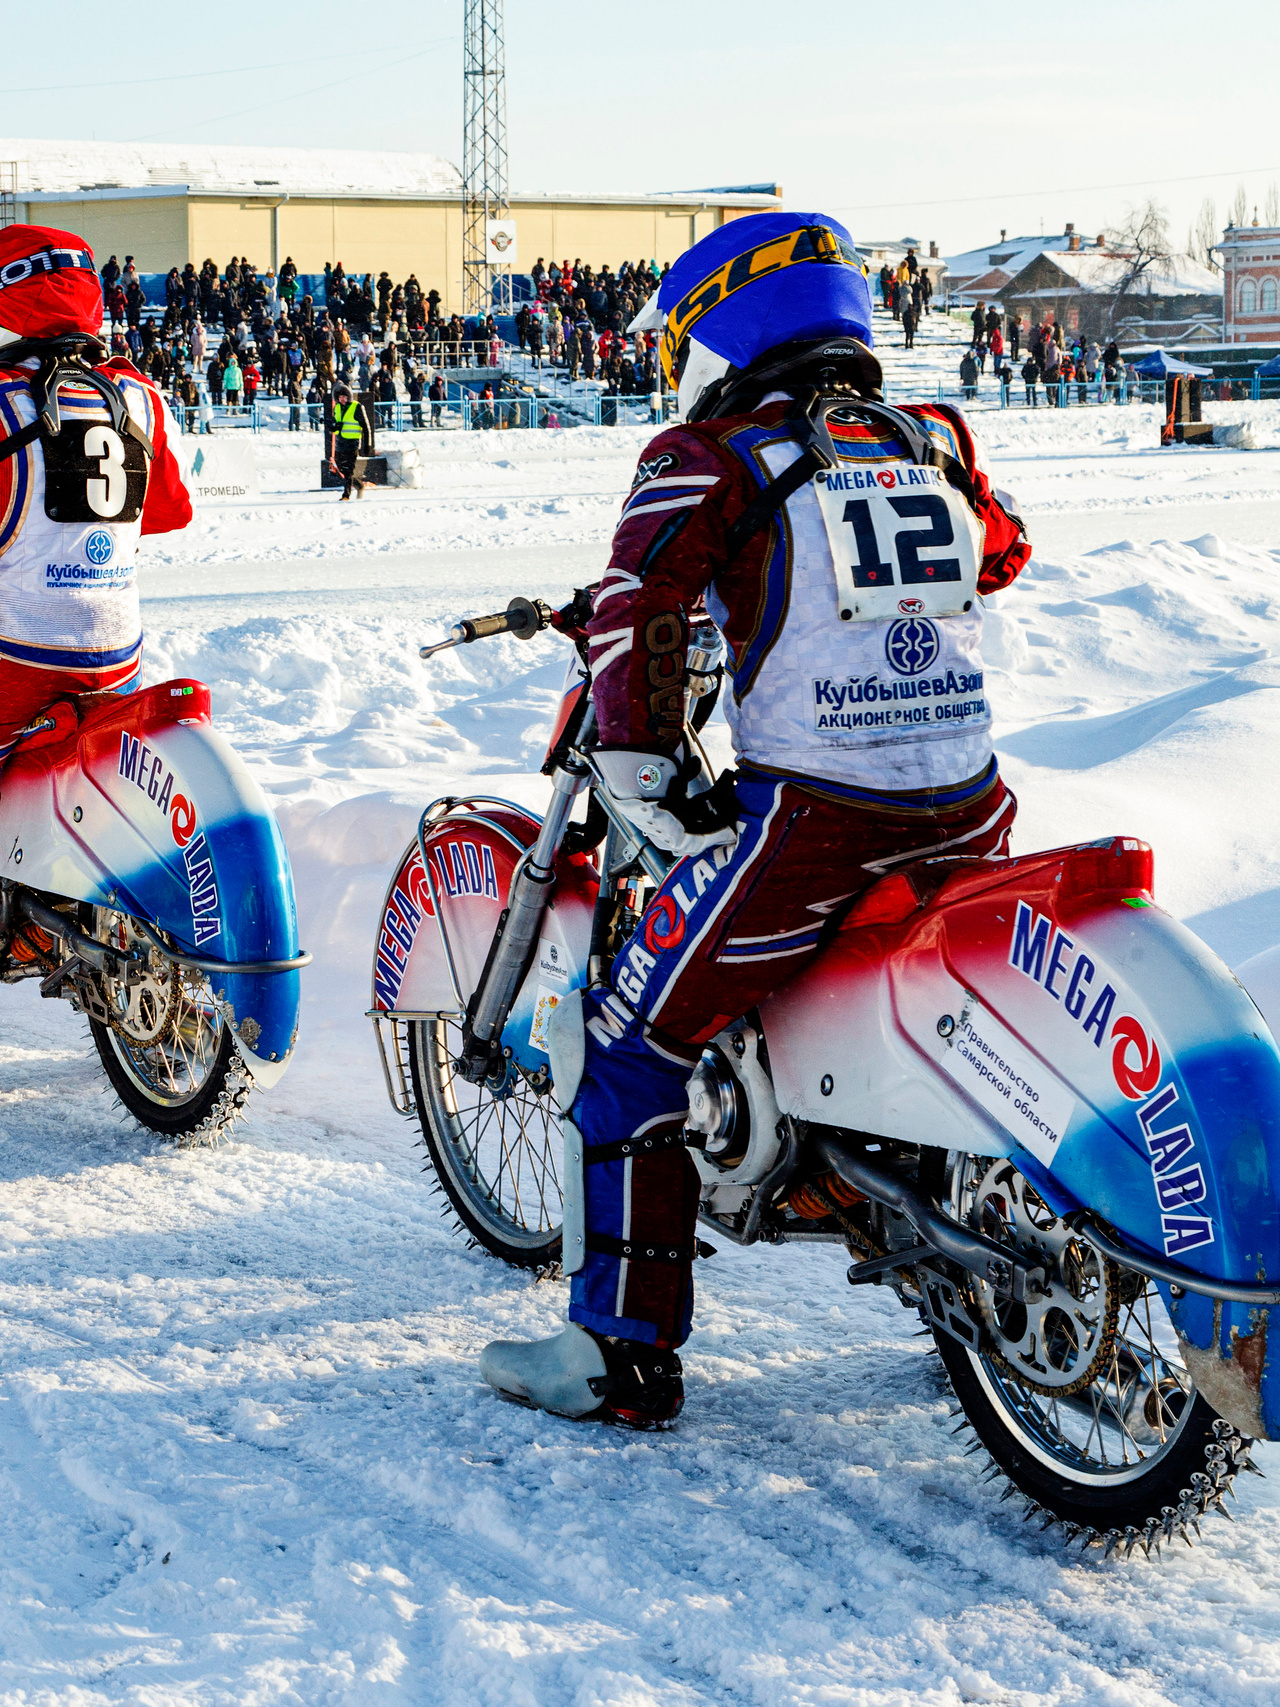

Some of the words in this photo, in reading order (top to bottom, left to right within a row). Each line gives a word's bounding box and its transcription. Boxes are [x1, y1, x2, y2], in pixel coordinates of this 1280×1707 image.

[84, 426, 128, 519] 3
[826, 470, 878, 491] MEGA
[895, 469, 941, 487] LADA
[842, 494, 962, 588] 12
[815, 670, 983, 711] КуйбышевАзот
[817, 707, 931, 730] АКЦИОНЕРНОЕ
[118, 731, 174, 816] MEGA
[183, 831, 221, 946] LADA
[375, 886, 422, 1011] MEGA
[434, 842, 499, 901] LADA
[585, 943, 658, 1049] MGA
[956, 1040, 1012, 1100] Самарской
[1014, 1098, 1059, 1144] области
[962, 1022, 1040, 1102] Правительство
[1008, 899, 1118, 1051] MEGA
[1135, 1081, 1215, 1258] LADA
